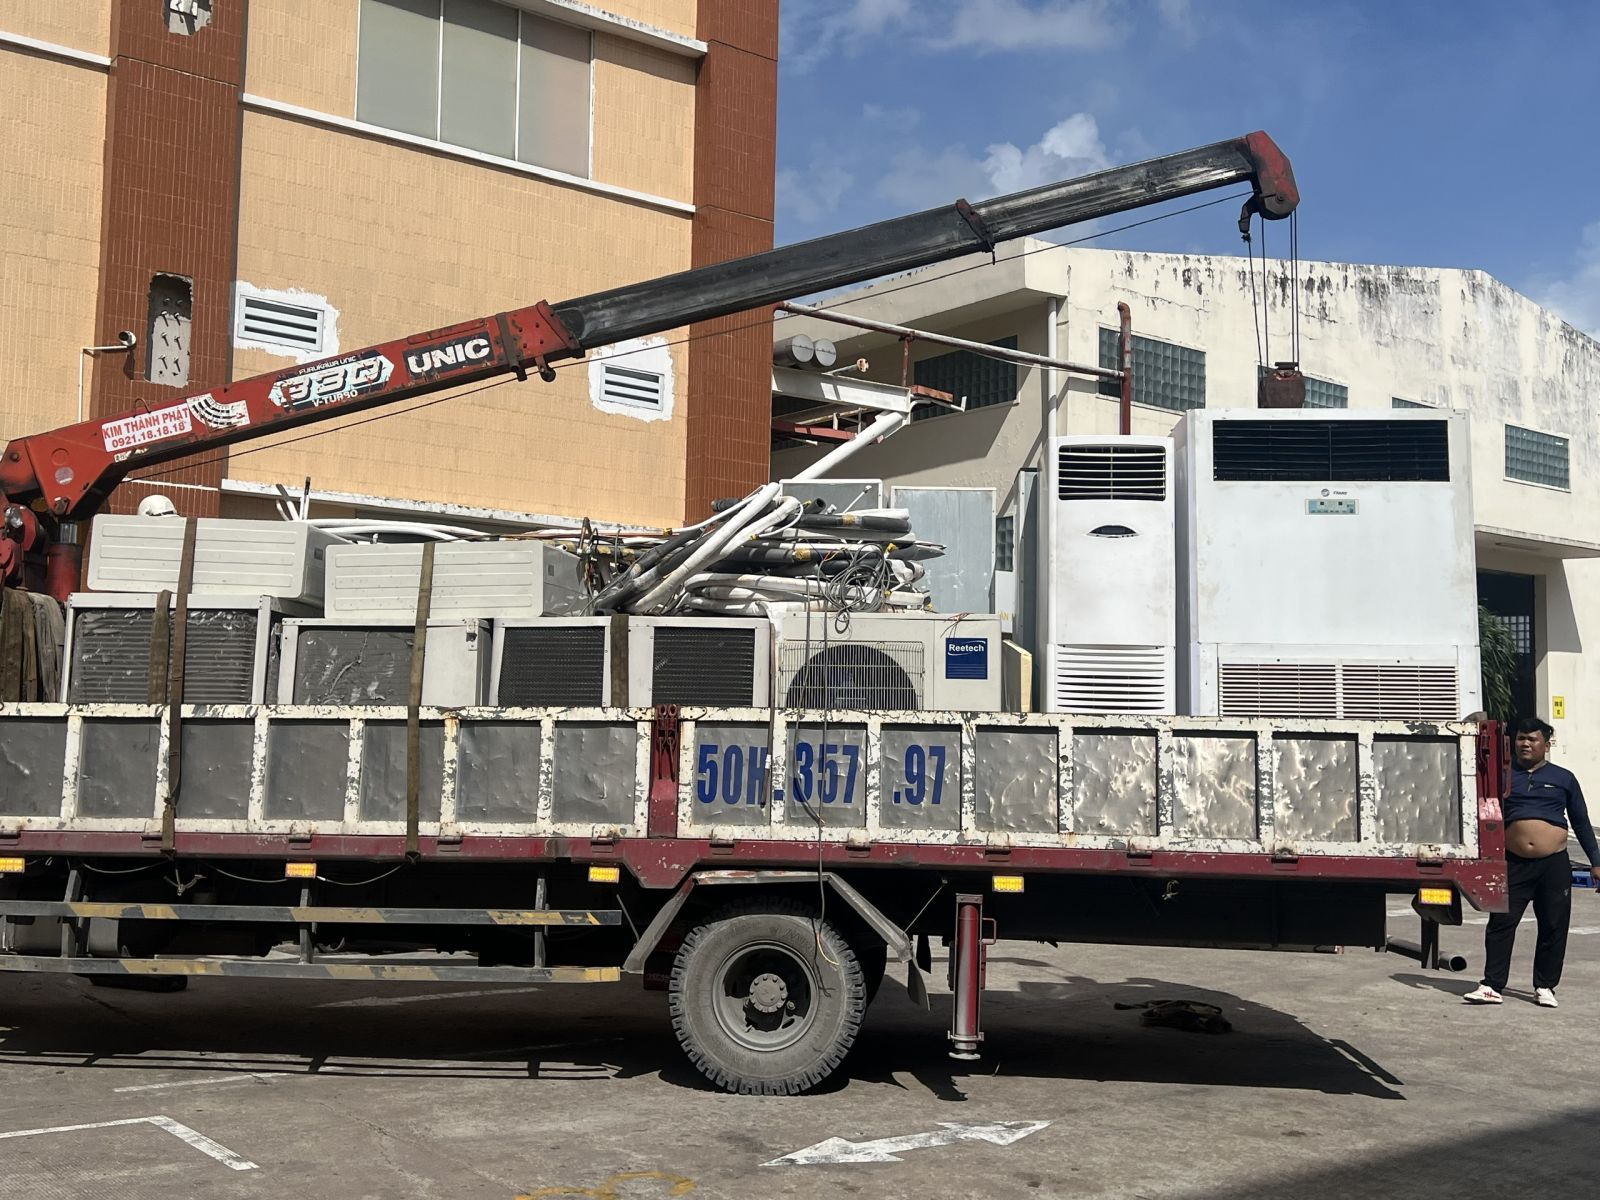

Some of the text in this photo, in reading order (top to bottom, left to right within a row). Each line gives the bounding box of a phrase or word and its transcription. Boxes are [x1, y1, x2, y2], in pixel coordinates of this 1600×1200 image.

[407, 338, 490, 374] UNIC
[102, 425, 123, 440] KIM
[126, 415, 160, 435] THÀNH
[111, 422, 186, 449] 0921.18.18.18
[948, 643, 985, 653] Reetech
